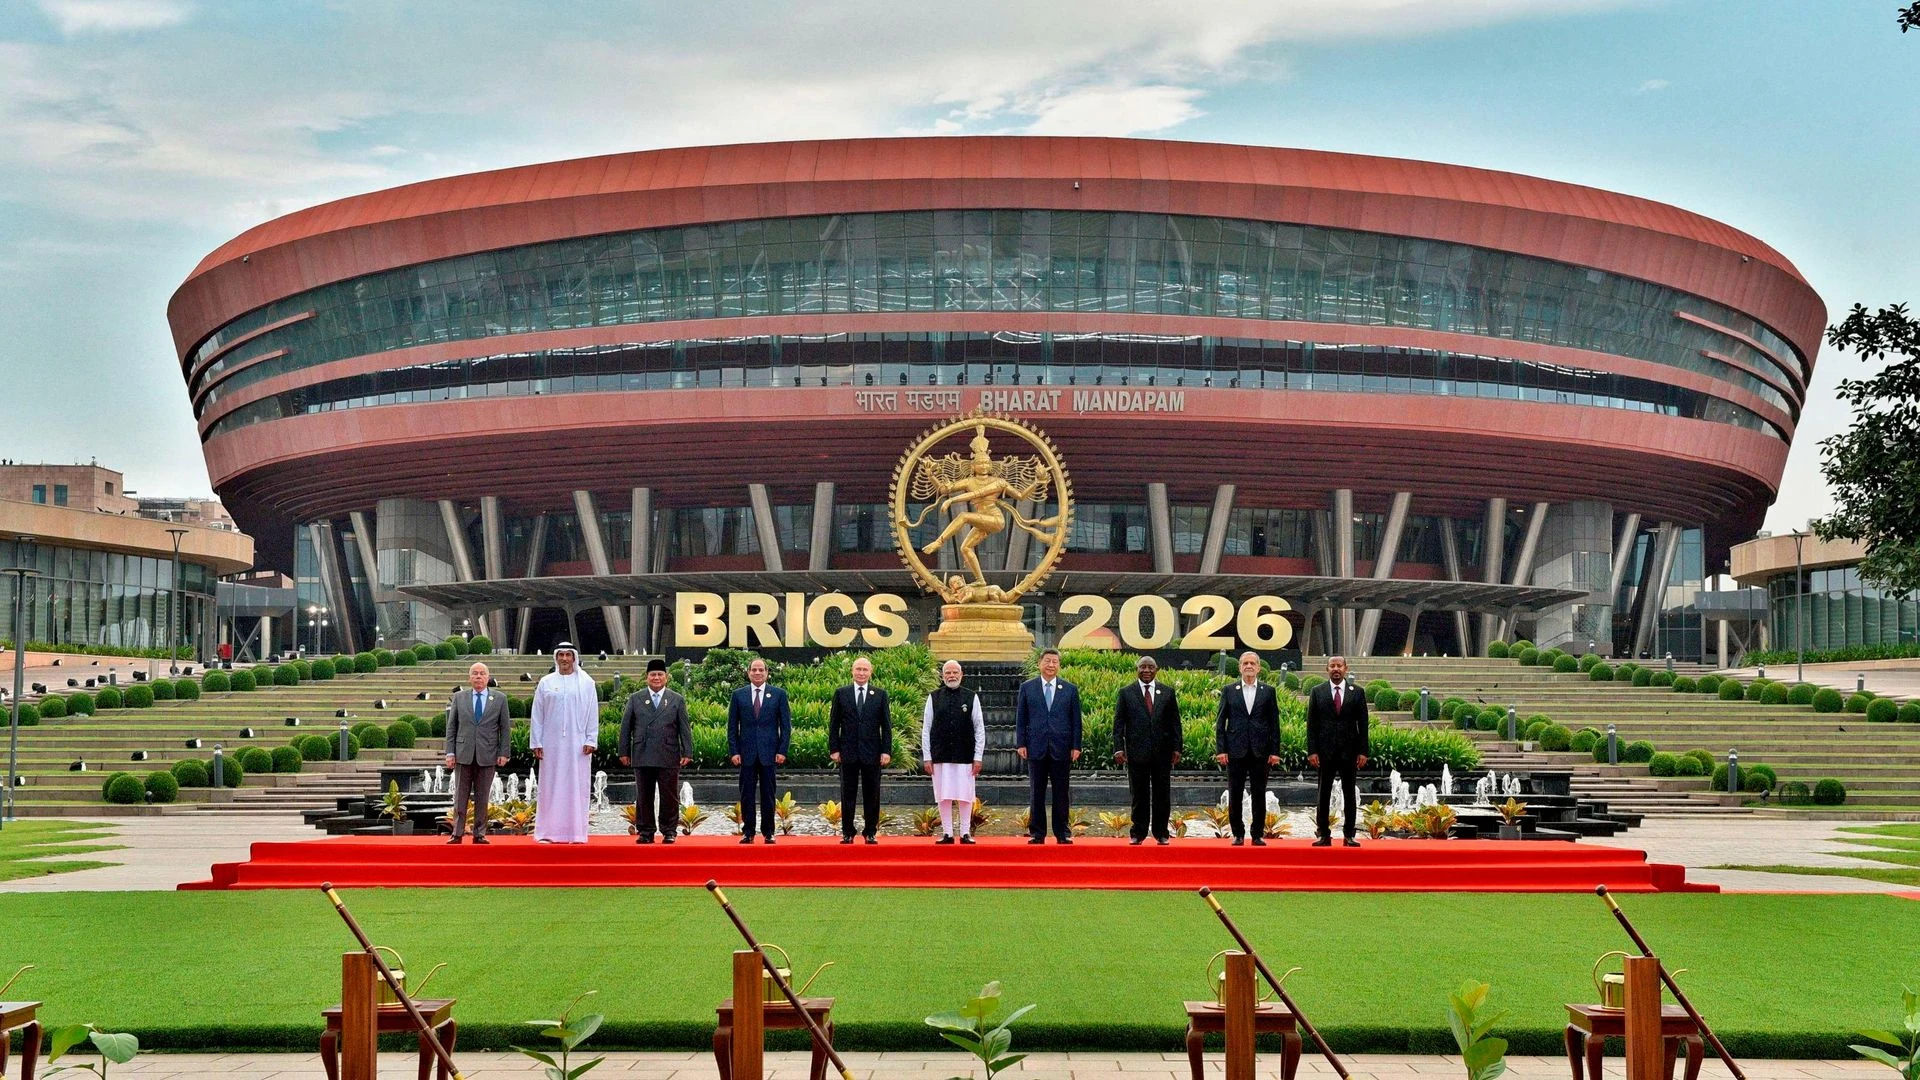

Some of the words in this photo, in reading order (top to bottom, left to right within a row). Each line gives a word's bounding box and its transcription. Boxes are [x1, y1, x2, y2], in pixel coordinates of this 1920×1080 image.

[855, 390, 899, 412] भारत
[981, 390, 1061, 412] BHARAT
[1073, 390, 1185, 412] MANDAPAM
[675, 592, 909, 648] BRICS
[1058, 594, 1293, 650] 2026
